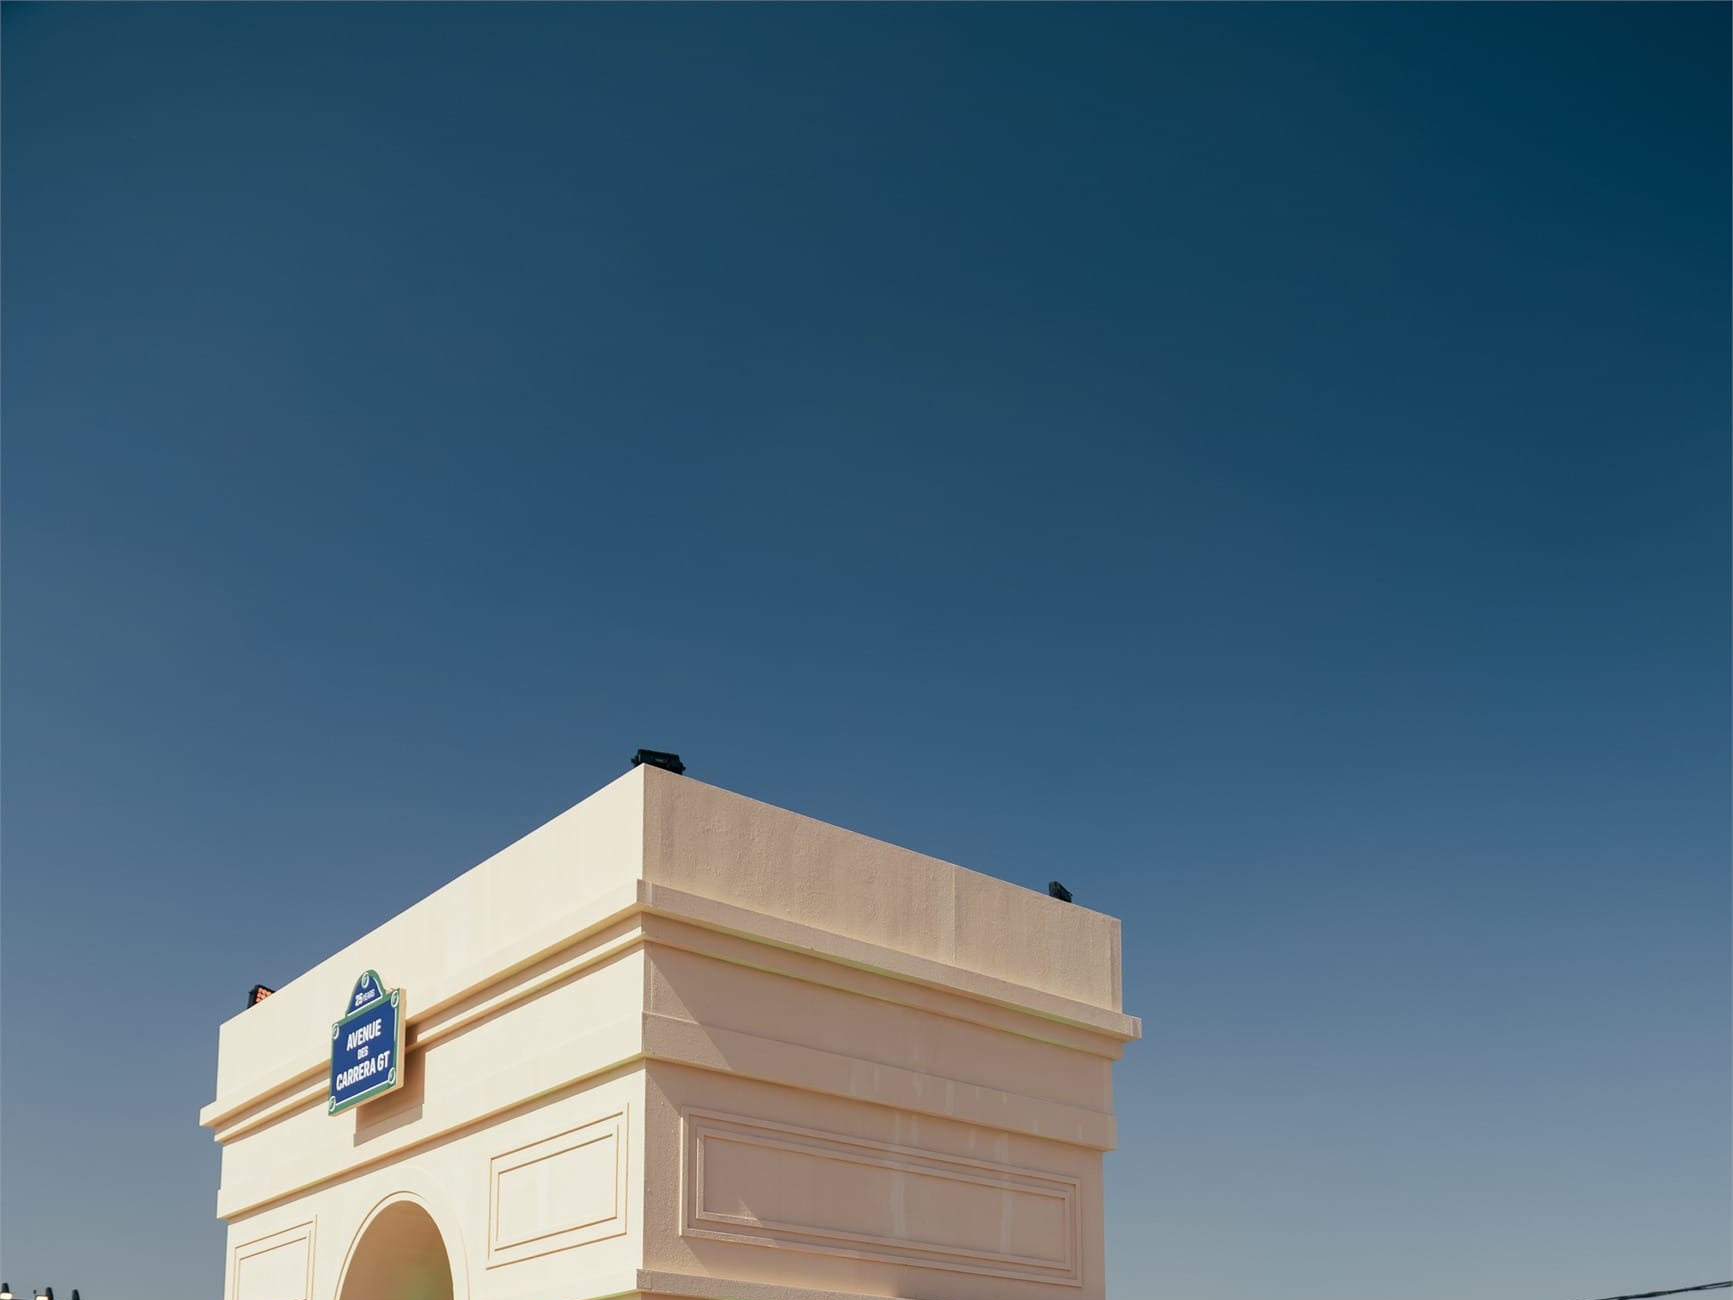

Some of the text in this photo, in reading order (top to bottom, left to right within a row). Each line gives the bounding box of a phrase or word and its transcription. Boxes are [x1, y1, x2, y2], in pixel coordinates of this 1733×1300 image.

[354, 993, 362, 1006] 25
[346, 1019, 381, 1051] AVENUE
[357, 1046, 368, 1059] DES
[336, 1051, 390, 1091] CARRERA GT
